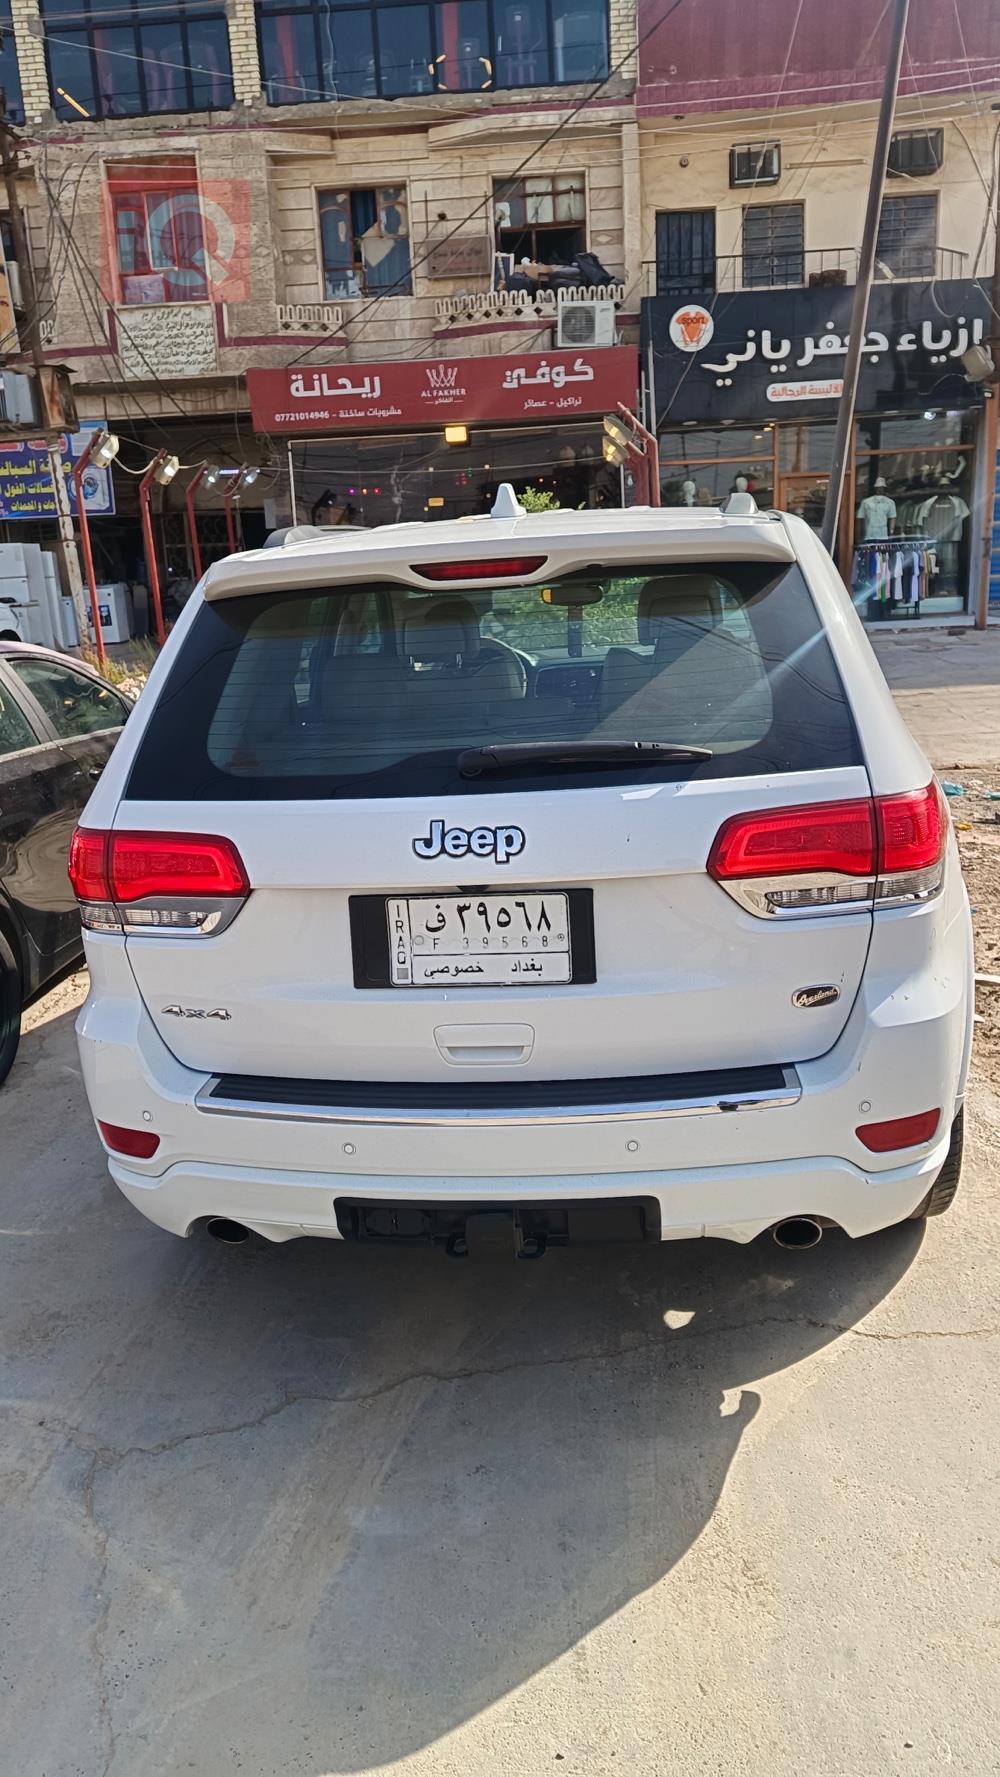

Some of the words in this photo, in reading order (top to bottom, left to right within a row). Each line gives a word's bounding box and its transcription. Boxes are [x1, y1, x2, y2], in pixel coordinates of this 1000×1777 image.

[896, 316, 983, 364] ازياء
[701, 329, 791, 387] ياني
[290, 373, 381, 398] ريحانة
[421, 390, 432, 398] AL
[433, 388, 466, 397] FAKHER
[412, 819, 526, 864] Jeep
[456, 901, 551, 934] ٣٩٥٦٨
[424, 961, 484, 979] خصوصي
[511, 959, 543, 977] بغداد
